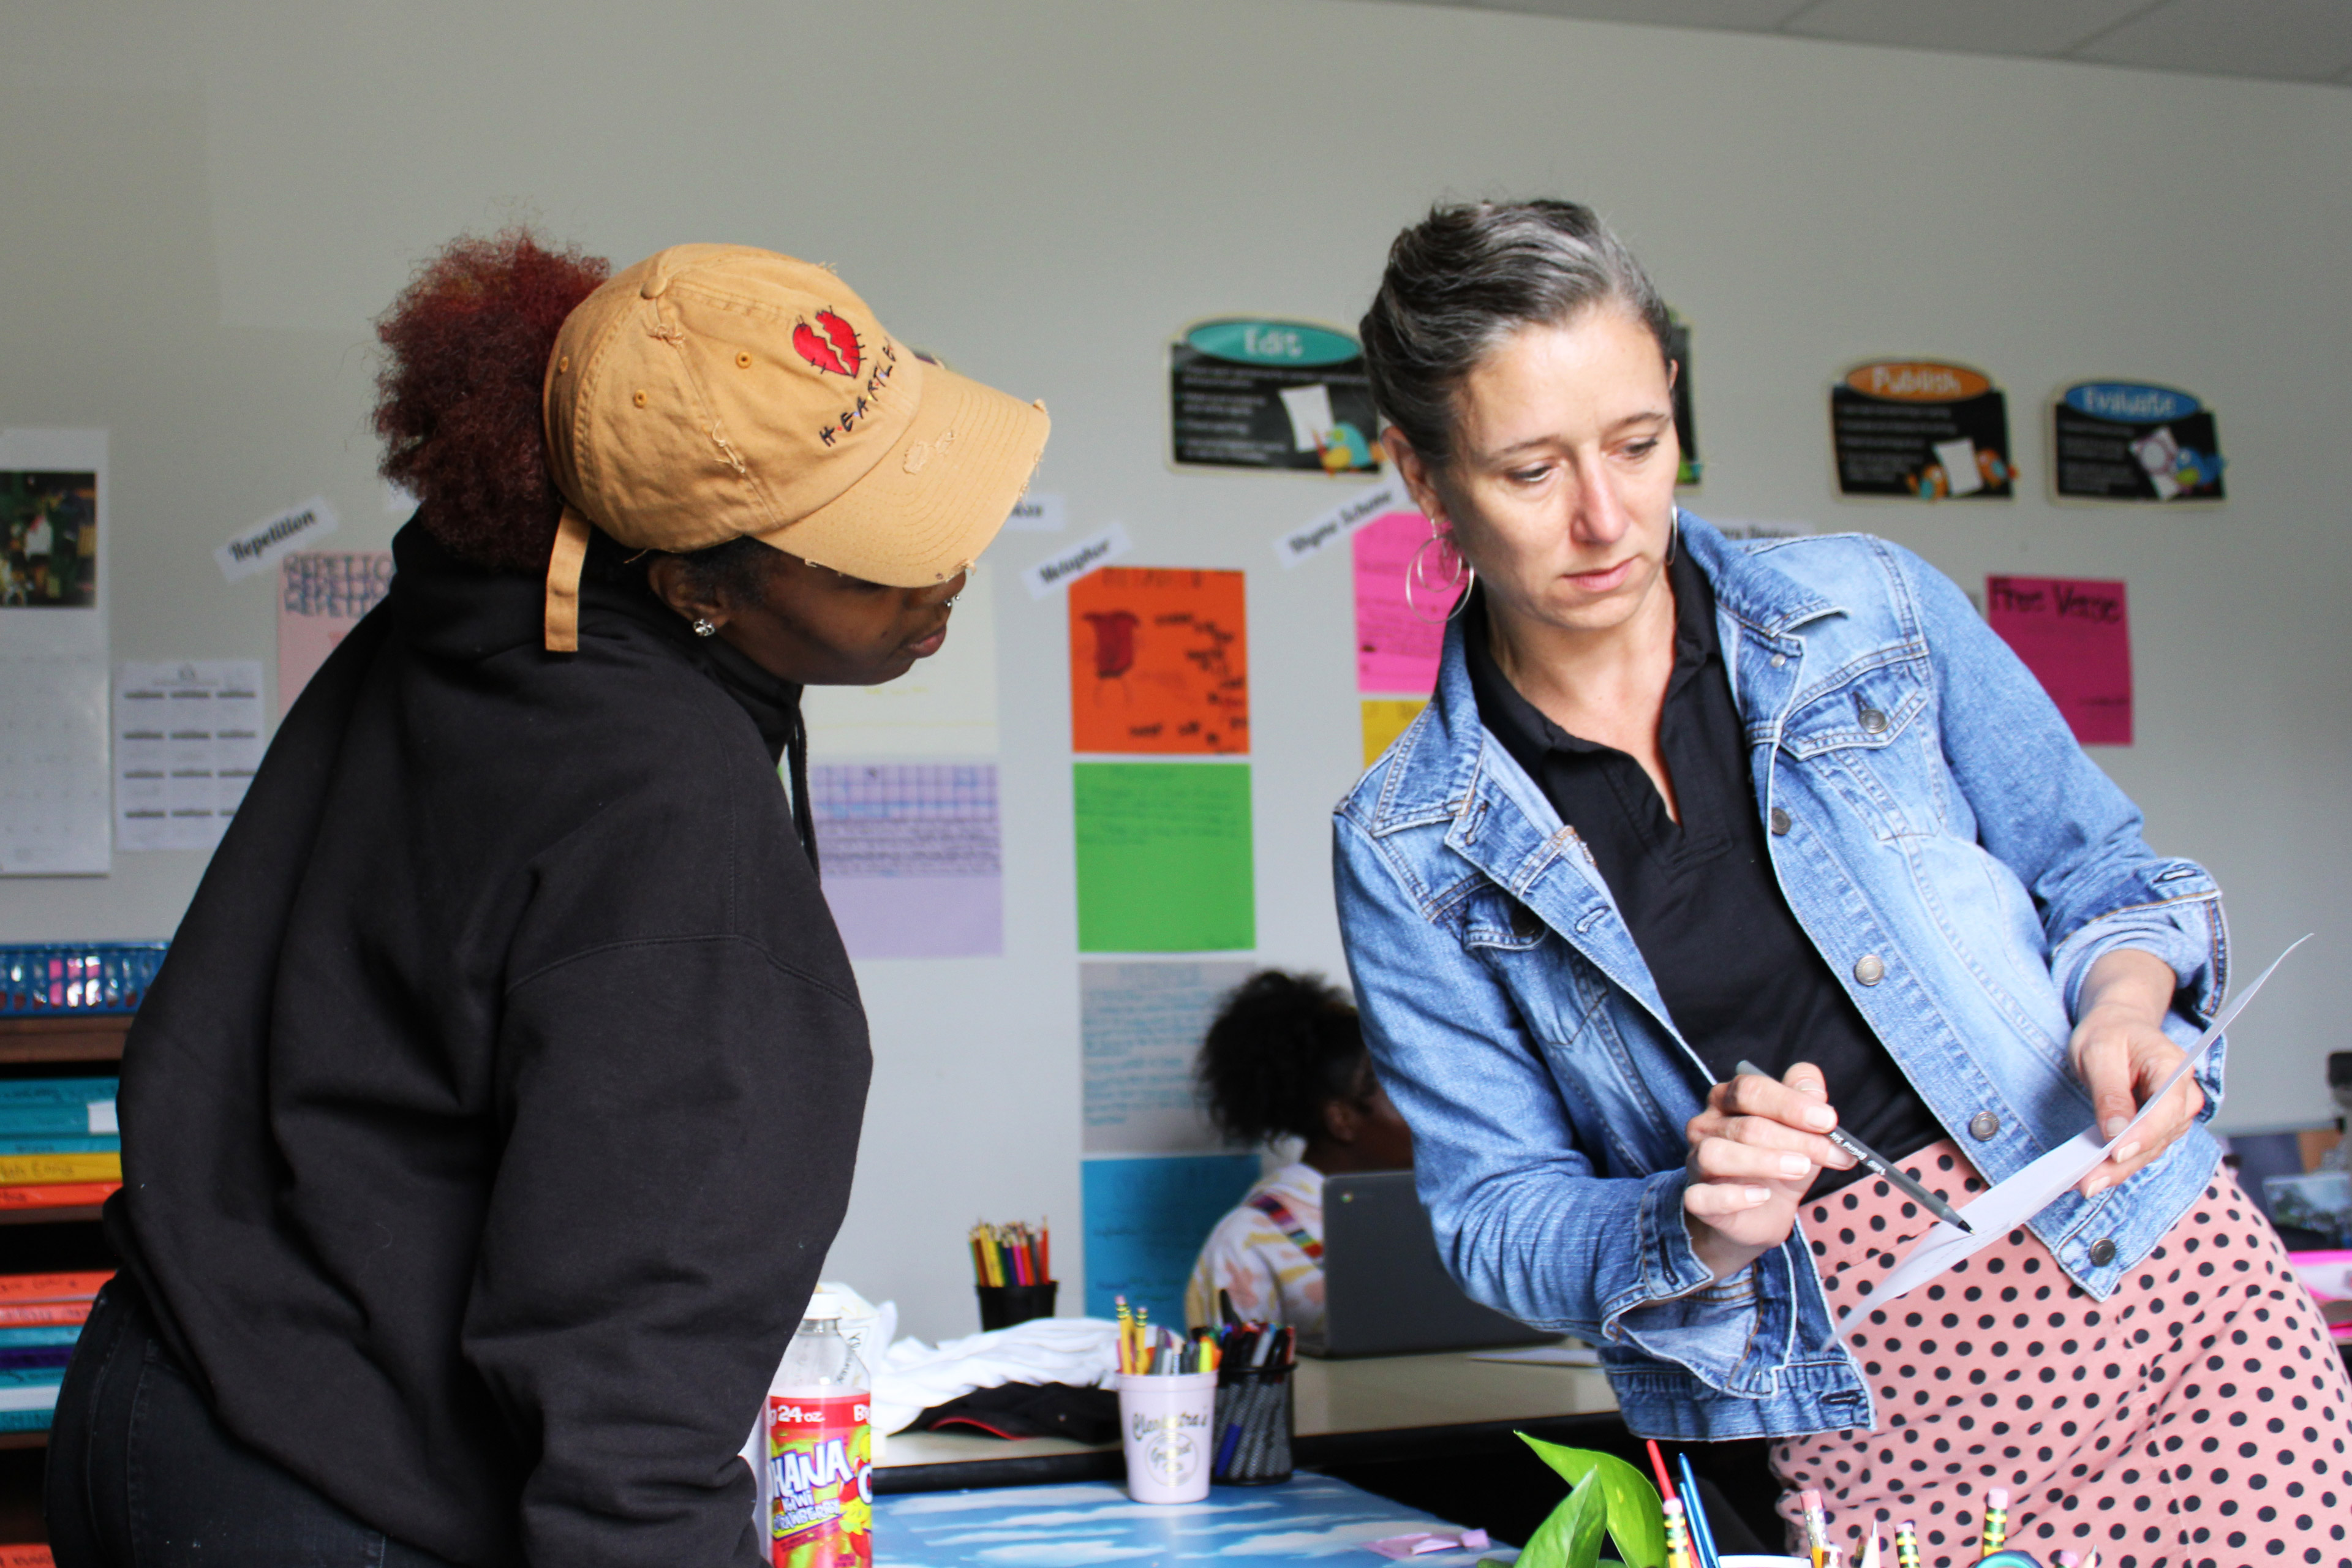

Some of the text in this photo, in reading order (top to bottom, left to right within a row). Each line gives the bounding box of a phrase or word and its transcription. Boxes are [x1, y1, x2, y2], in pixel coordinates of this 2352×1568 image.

[1244, 325, 1303, 357] Edit
[230, 510, 317, 562] Repetition
[1039, 539, 1109, 582] Metaphor
[1992, 577, 2045, 612] Free
[778, 1404, 803, 1423] 24
